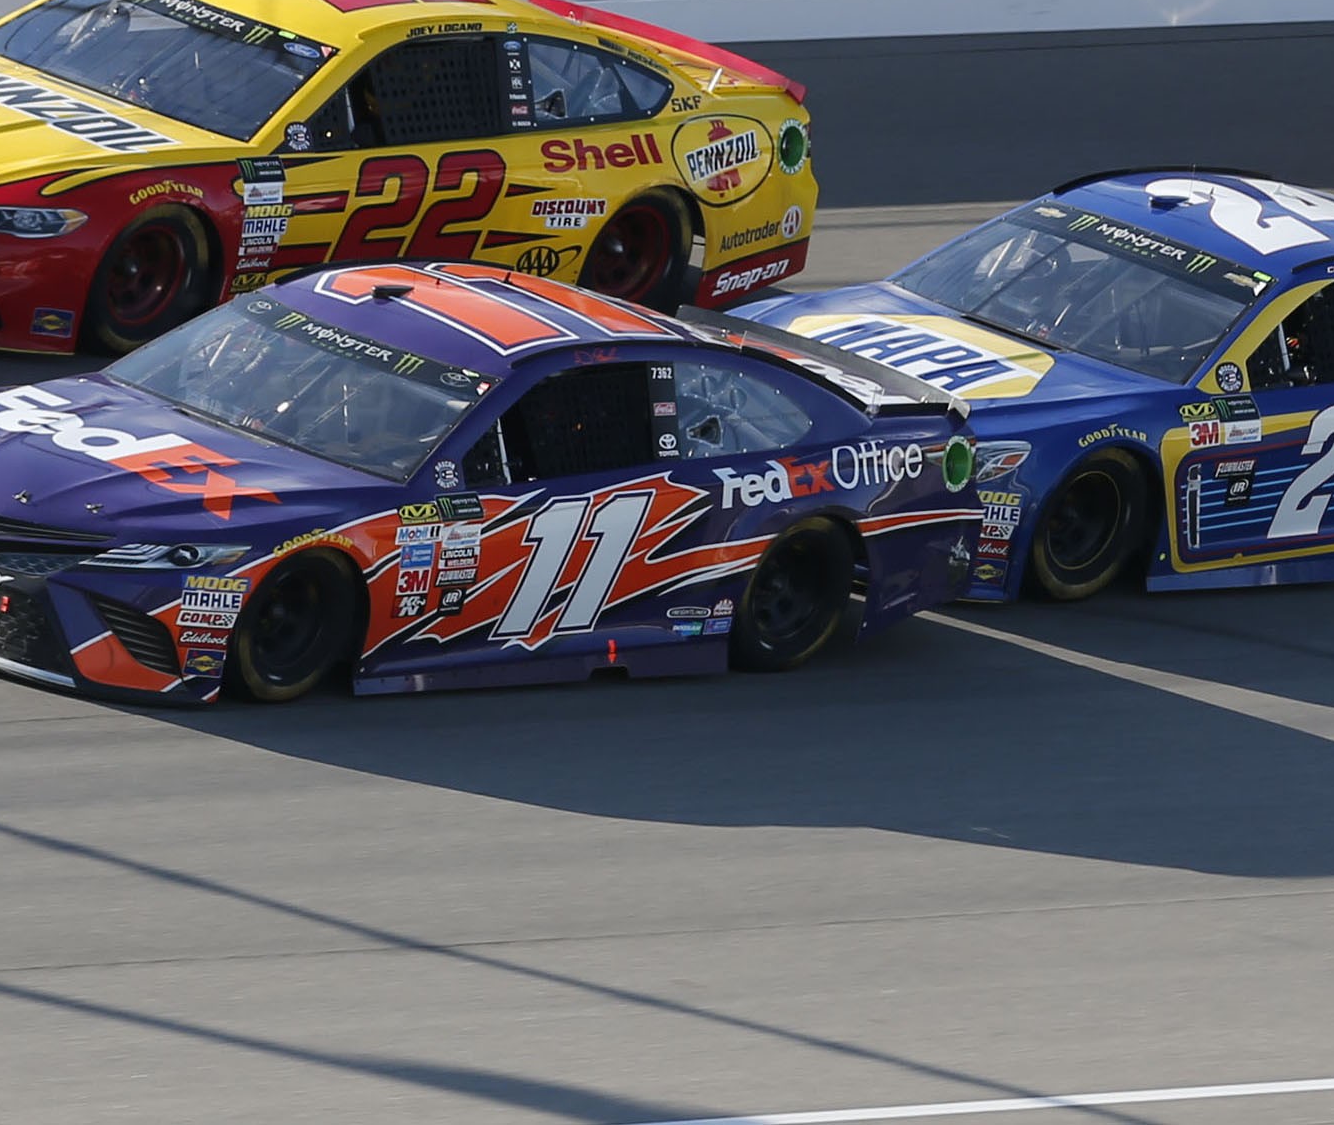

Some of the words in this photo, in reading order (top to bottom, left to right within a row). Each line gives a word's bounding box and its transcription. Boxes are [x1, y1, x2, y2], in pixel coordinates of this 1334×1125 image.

[406, 25, 435, 37] JOEY
[438, 22, 483, 33] LOGANO
[671, 95, 702, 113] SKF
[540, 133, 663, 173] Shell
[685, 131, 759, 181] PENNZOIL
[129, 179, 204, 205] GOODYEAR
[245, 204, 293, 218] MOOG
[335, 148, 507, 263] 22
[532, 199, 607, 216] DISCOUNT
[243, 218, 286, 234] MAHLE
[548, 217, 582, 227] TIRE
[242, 236, 273, 246] LINCOLN
[719, 220, 781, 253] Autotrader
[1096, 223, 1188, 261] MONSTER
[519, 247, 559, 276] AAA
[711, 259, 789, 297] Snap-on
[301, 322, 393, 362] MONSTER
[815, 320, 1015, 392] NAPA
[651, 367, 673, 379] 7362
[1078, 423, 1147, 448] GOODYEAR
[1191, 422, 1219, 446] 3M
[712, 455, 836, 510] FedEx
[831, 438, 924, 491] Office
[1215, 460, 1256, 478] FLOWMASTER
[977, 491, 1022, 505] OOG
[273, 528, 354, 558] GOODYEAR
[398, 527, 429, 540] Mobil
[441, 548, 474, 559] LINCOLN
[488, 489, 659, 643] 11
[184, 575, 249, 592] MOOG
[398, 569, 430, 593] 3M
[182, 593, 241, 610] MAHLE
[180, 611, 223, 625] COMP
[180, 630, 228, 645] Edelbrock
